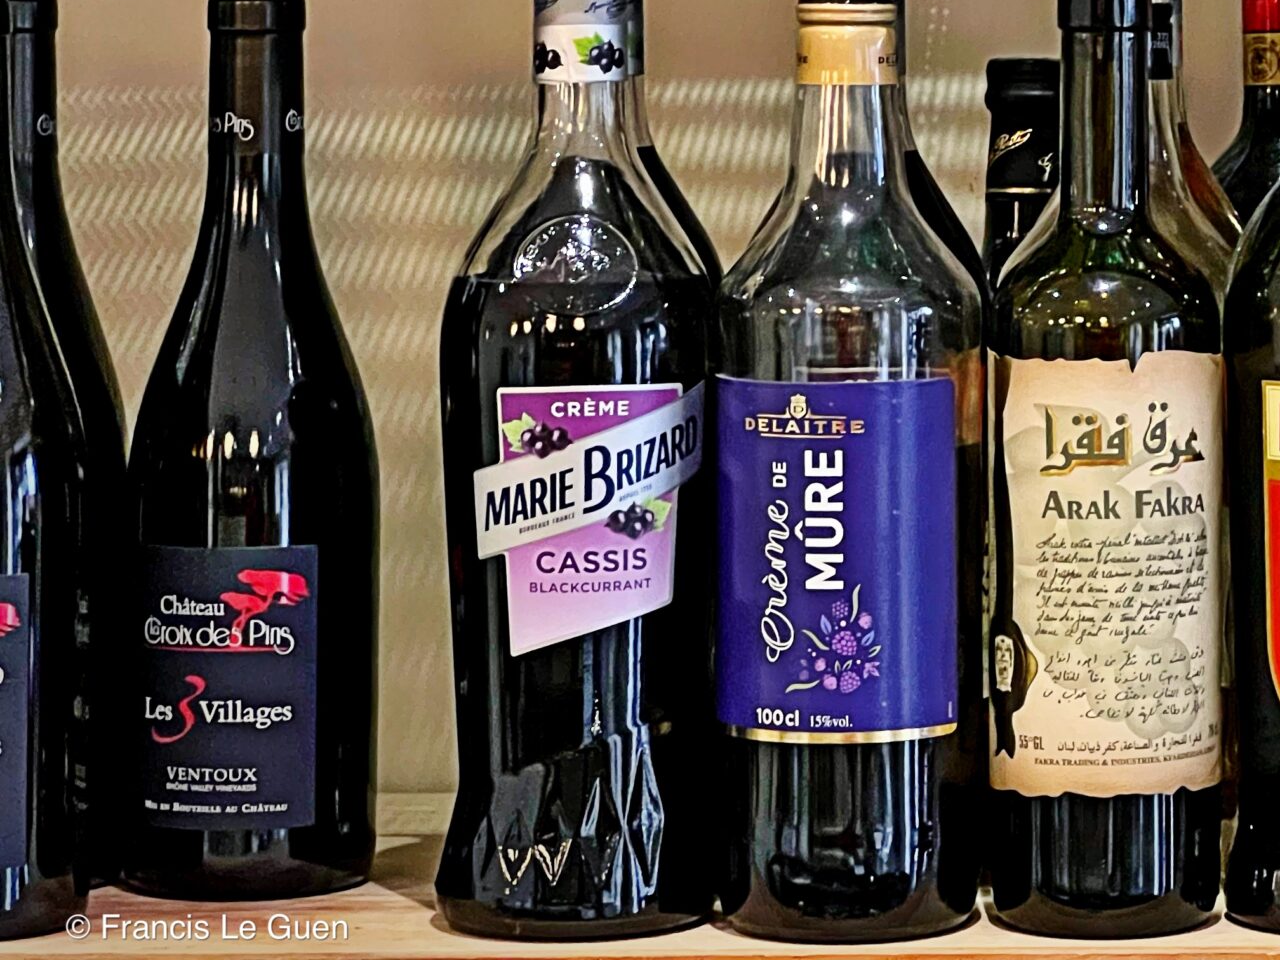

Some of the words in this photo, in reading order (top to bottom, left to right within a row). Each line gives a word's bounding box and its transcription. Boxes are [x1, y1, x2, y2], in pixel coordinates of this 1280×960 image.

[551, 397, 630, 418] CRÈME
[745, 417, 866, 435] DELAITRE
[484, 467, 575, 532] MARIE
[583, 415, 697, 515] BRIZARD
[772, 462, 787, 488] DE
[793, 449, 844, 591] MÛRE
[536, 547, 648, 574] CASSIS
[529, 578, 651, 594] BLACKCURRANT
[761, 500, 794, 663] Crème
[160, 594, 225, 616] Château
[145, 617, 193, 646] Croix
[196, 620, 242, 647] des
[249, 619, 295, 655] Pins
[145, 697, 173, 721] Les
[151, 674, 207, 744] 3
[199, 699, 293, 729] Villages
[167, 766, 258, 782] VENTOUX
